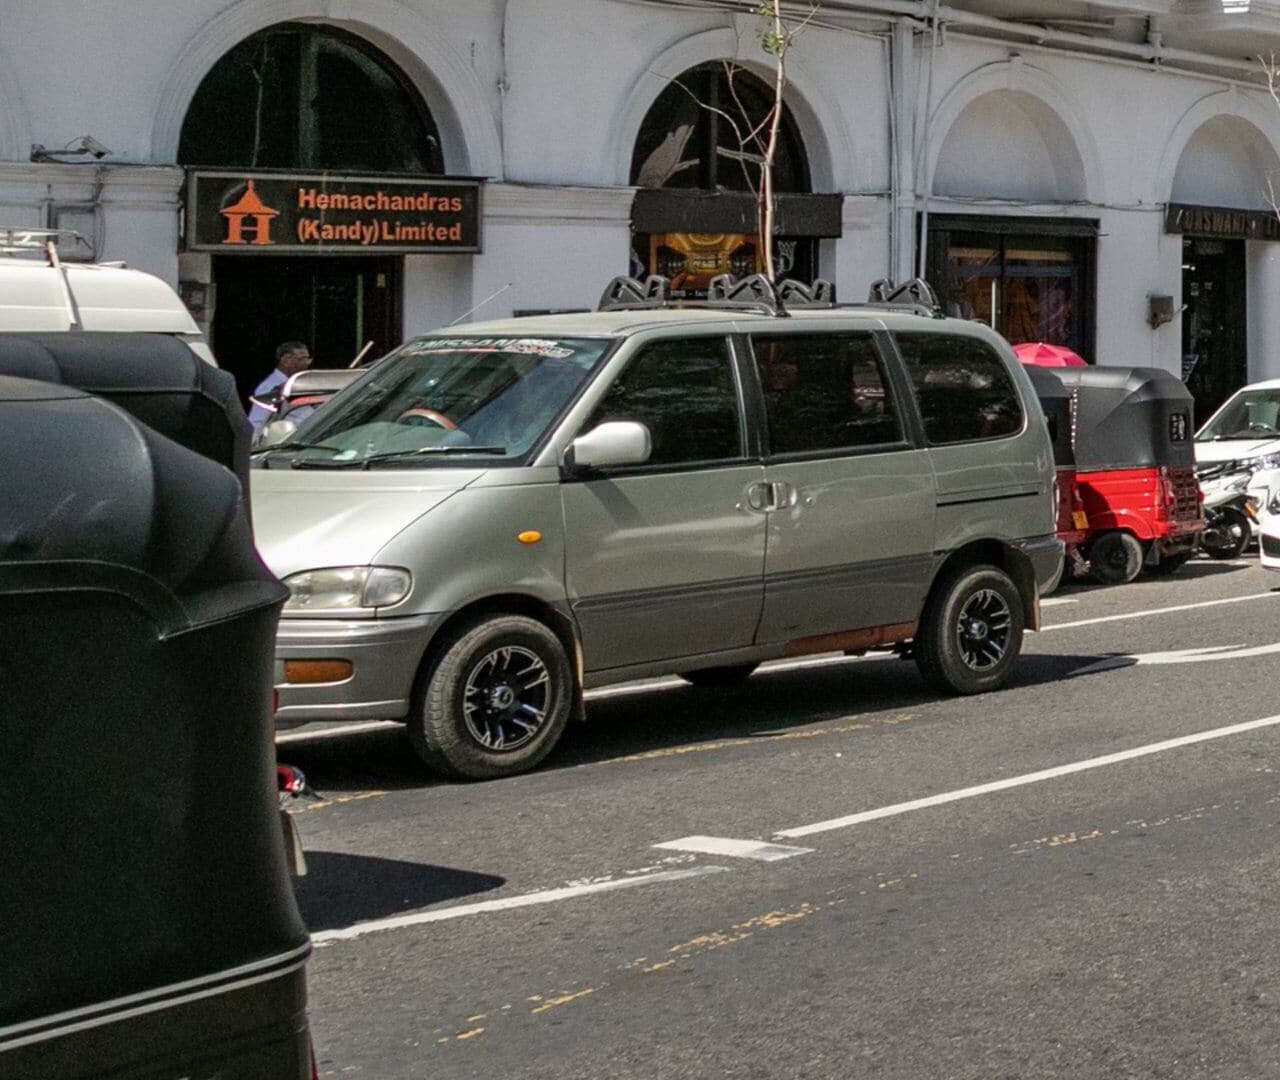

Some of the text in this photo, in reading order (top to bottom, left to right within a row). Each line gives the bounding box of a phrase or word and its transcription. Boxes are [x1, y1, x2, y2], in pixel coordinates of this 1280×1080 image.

[298, 188, 463, 212] Hemachandras
[297, 218, 462, 245] (Kandy) Limited
